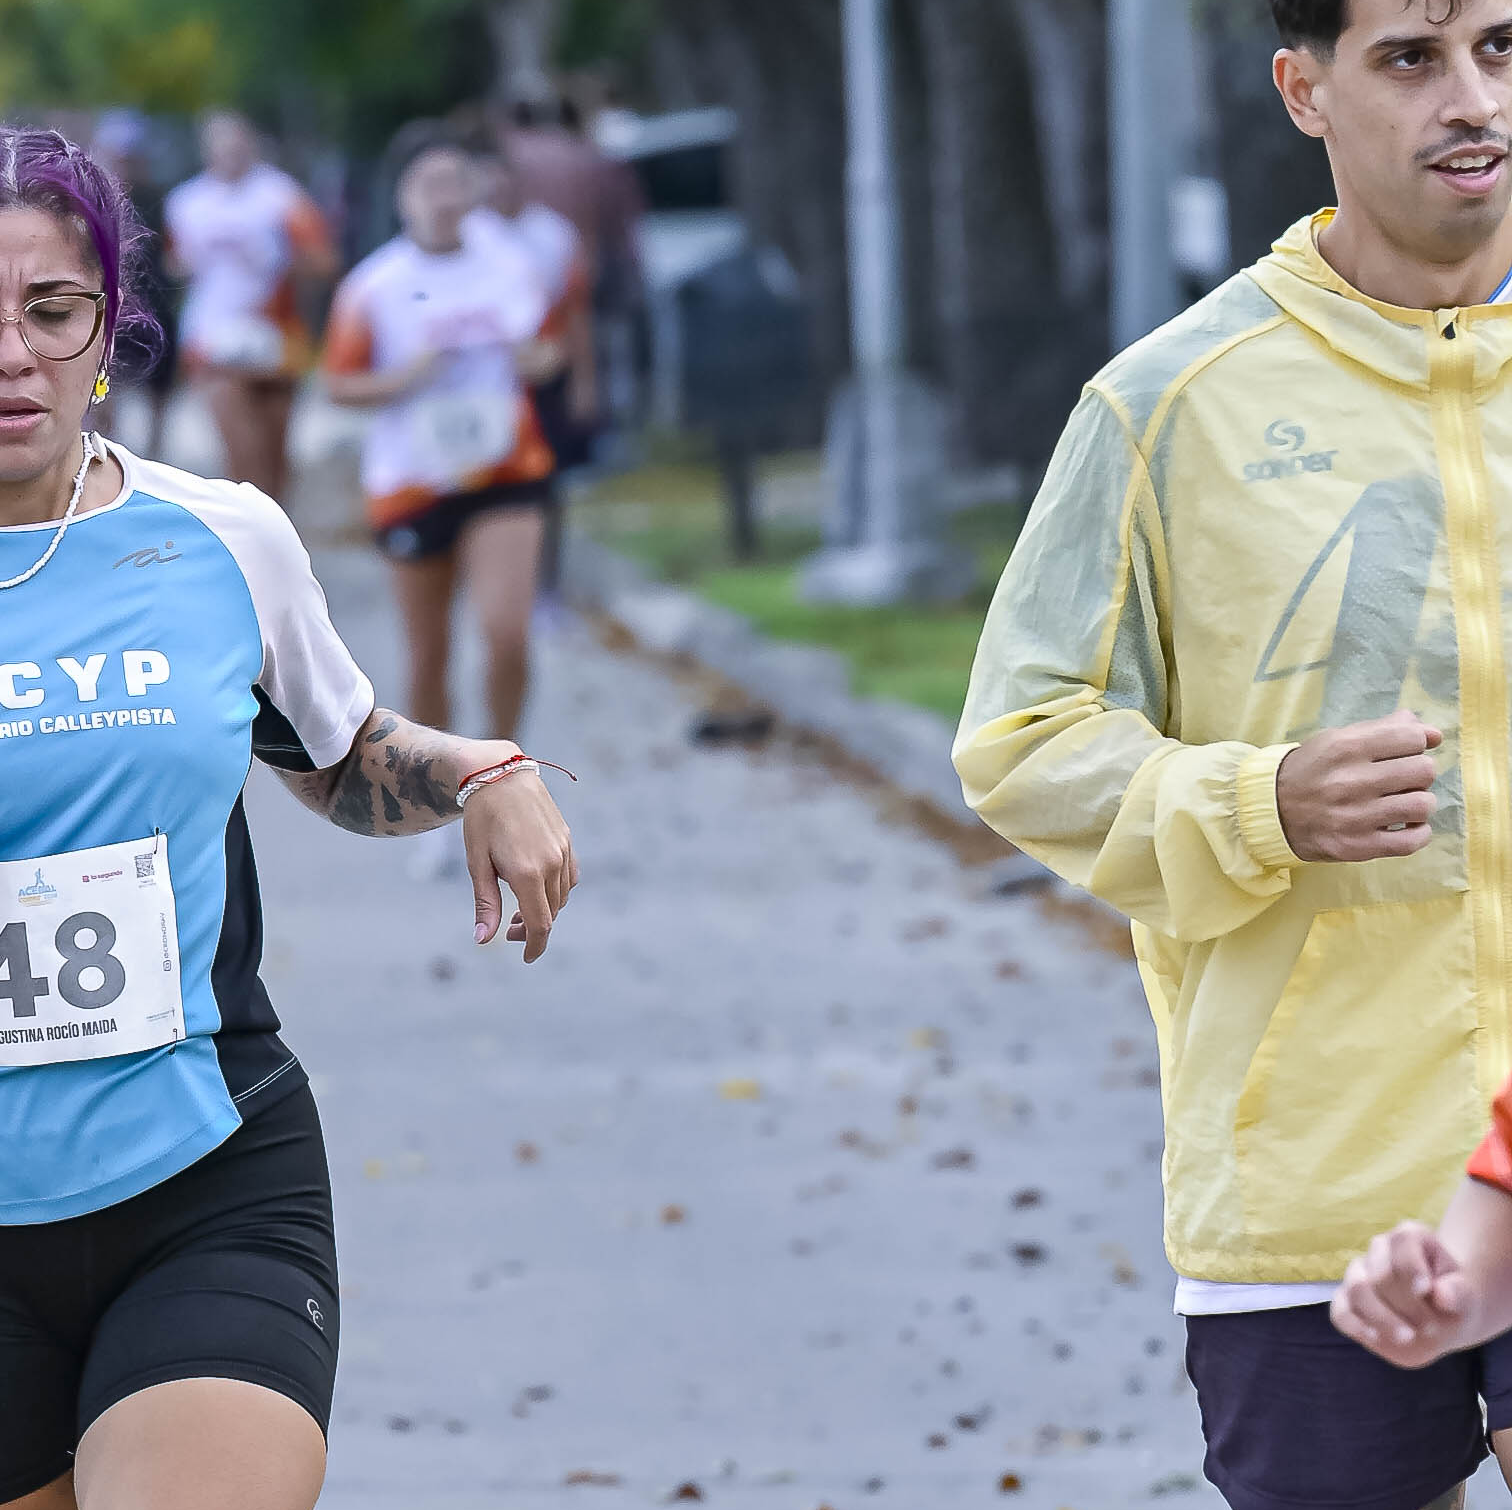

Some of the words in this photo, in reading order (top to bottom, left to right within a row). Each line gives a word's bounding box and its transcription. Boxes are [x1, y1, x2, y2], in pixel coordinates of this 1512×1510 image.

[40, 708, 177, 734] CALLEYPISTA
[46, 1021, 80, 1041] ROCÍO
[81, 1018, 118, 1037] MAIDA
